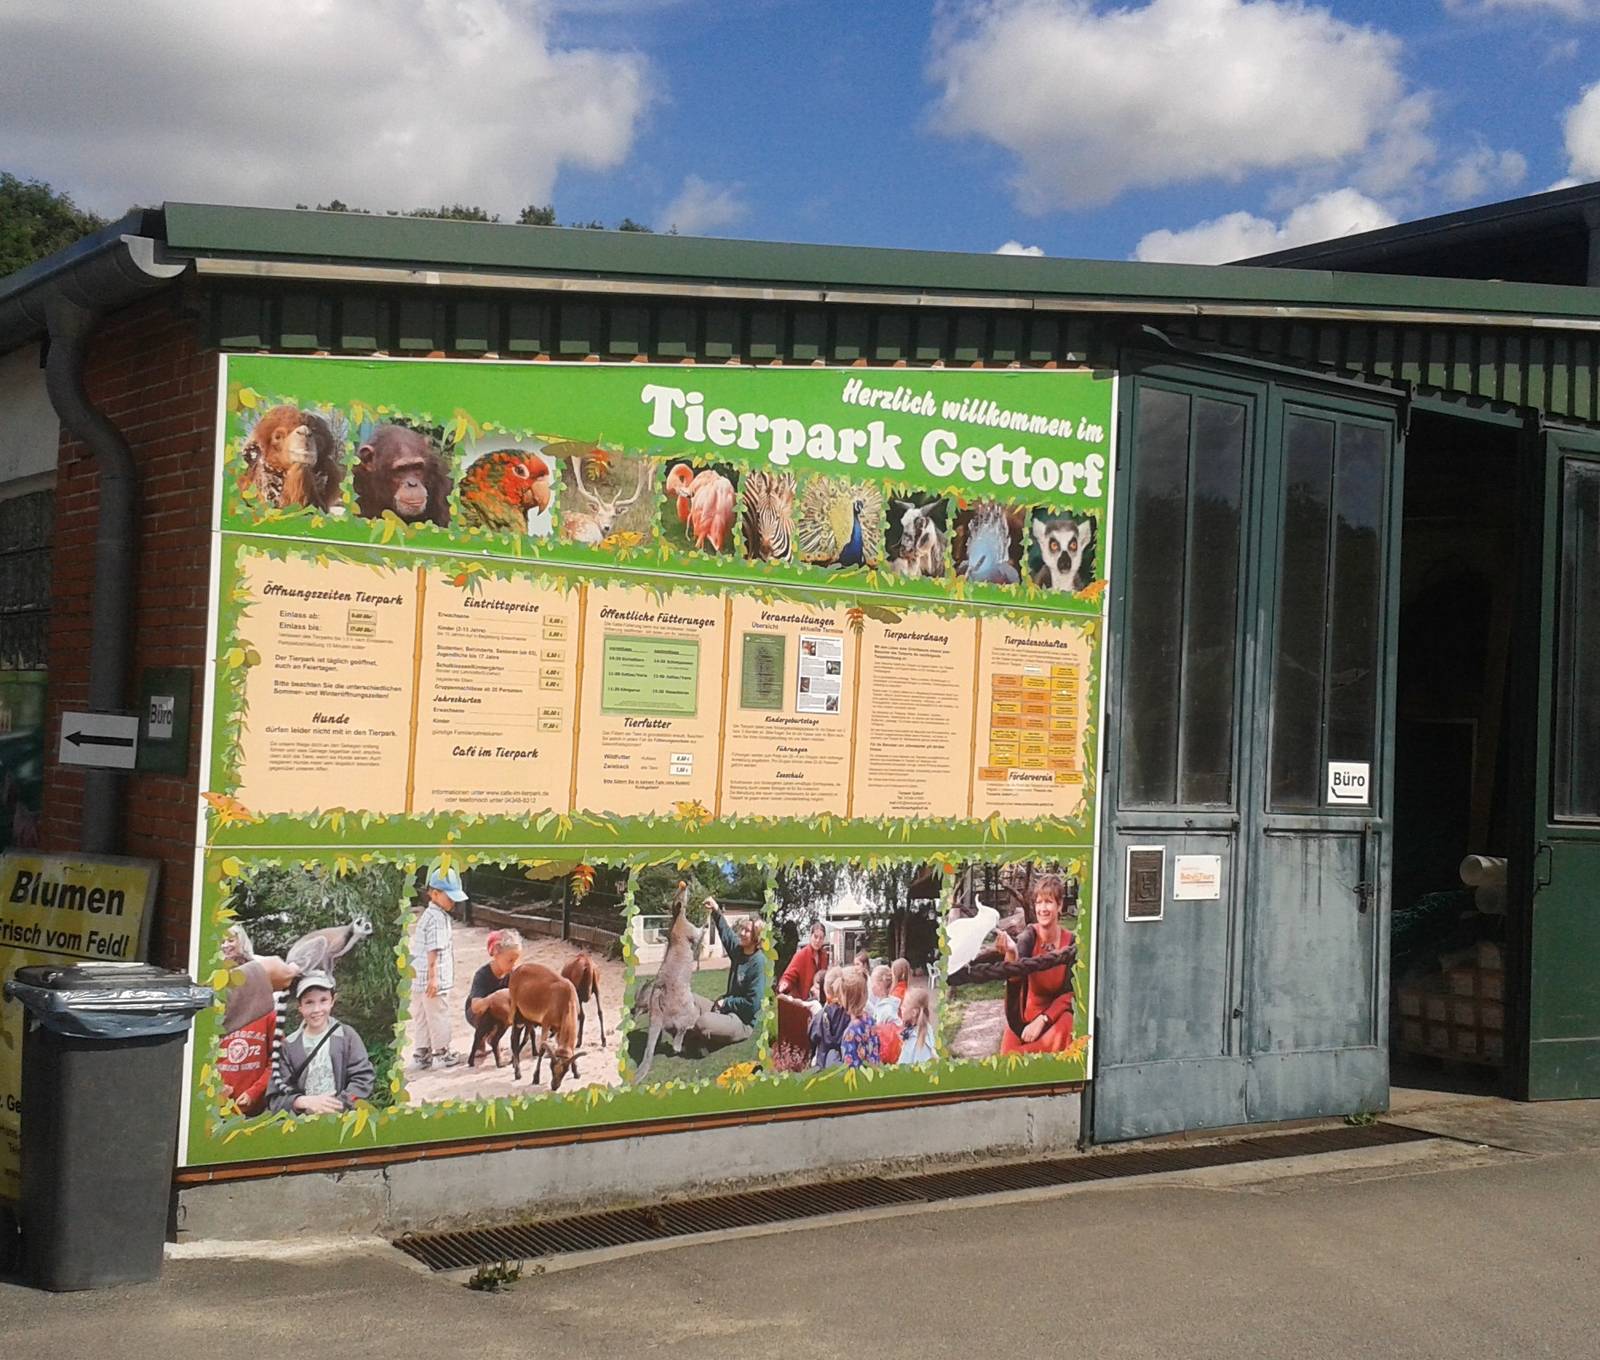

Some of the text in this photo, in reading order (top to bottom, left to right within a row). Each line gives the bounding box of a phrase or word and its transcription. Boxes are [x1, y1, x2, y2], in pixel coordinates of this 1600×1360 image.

[842, 378, 1104, 443] Herzlich willkommen im
[641, 384, 1104, 498] Tierpark Gettorf
[263, 580, 403, 606] Öffnungszeiten Tierpark
[464, 597, 540, 614] Eintrittspreise
[280, 610, 307, 619] Einlass
[600, 605, 655, 622] Öffentliche
[656, 612, 716, 628] Fütterungen
[760, 610, 835, 628] Veranstaltungen
[279, 622, 306, 630] Einlass
[752, 621, 778, 630] Übersicht
[884, 628, 948, 646] Tierparkordnung
[1004, 636, 1068, 648] Tierpatenschaften
[288, 655, 315, 663] Tierpark
[433, 695, 482, 704] Jahreskarten
[150, 704, 173, 725] Büro
[312, 712, 350, 724] Hunde
[624, 717, 672, 729] Tierfutter
[452, 745, 540, 760] Café im Tierpark
[776, 746, 808, 754] Führungen
[1009, 771, 1052, 782] Förderverein
[1334, 771, 1366, 787] Büro
[9, 870, 125, 916] Blumen
[46, 930, 82, 951] vom
